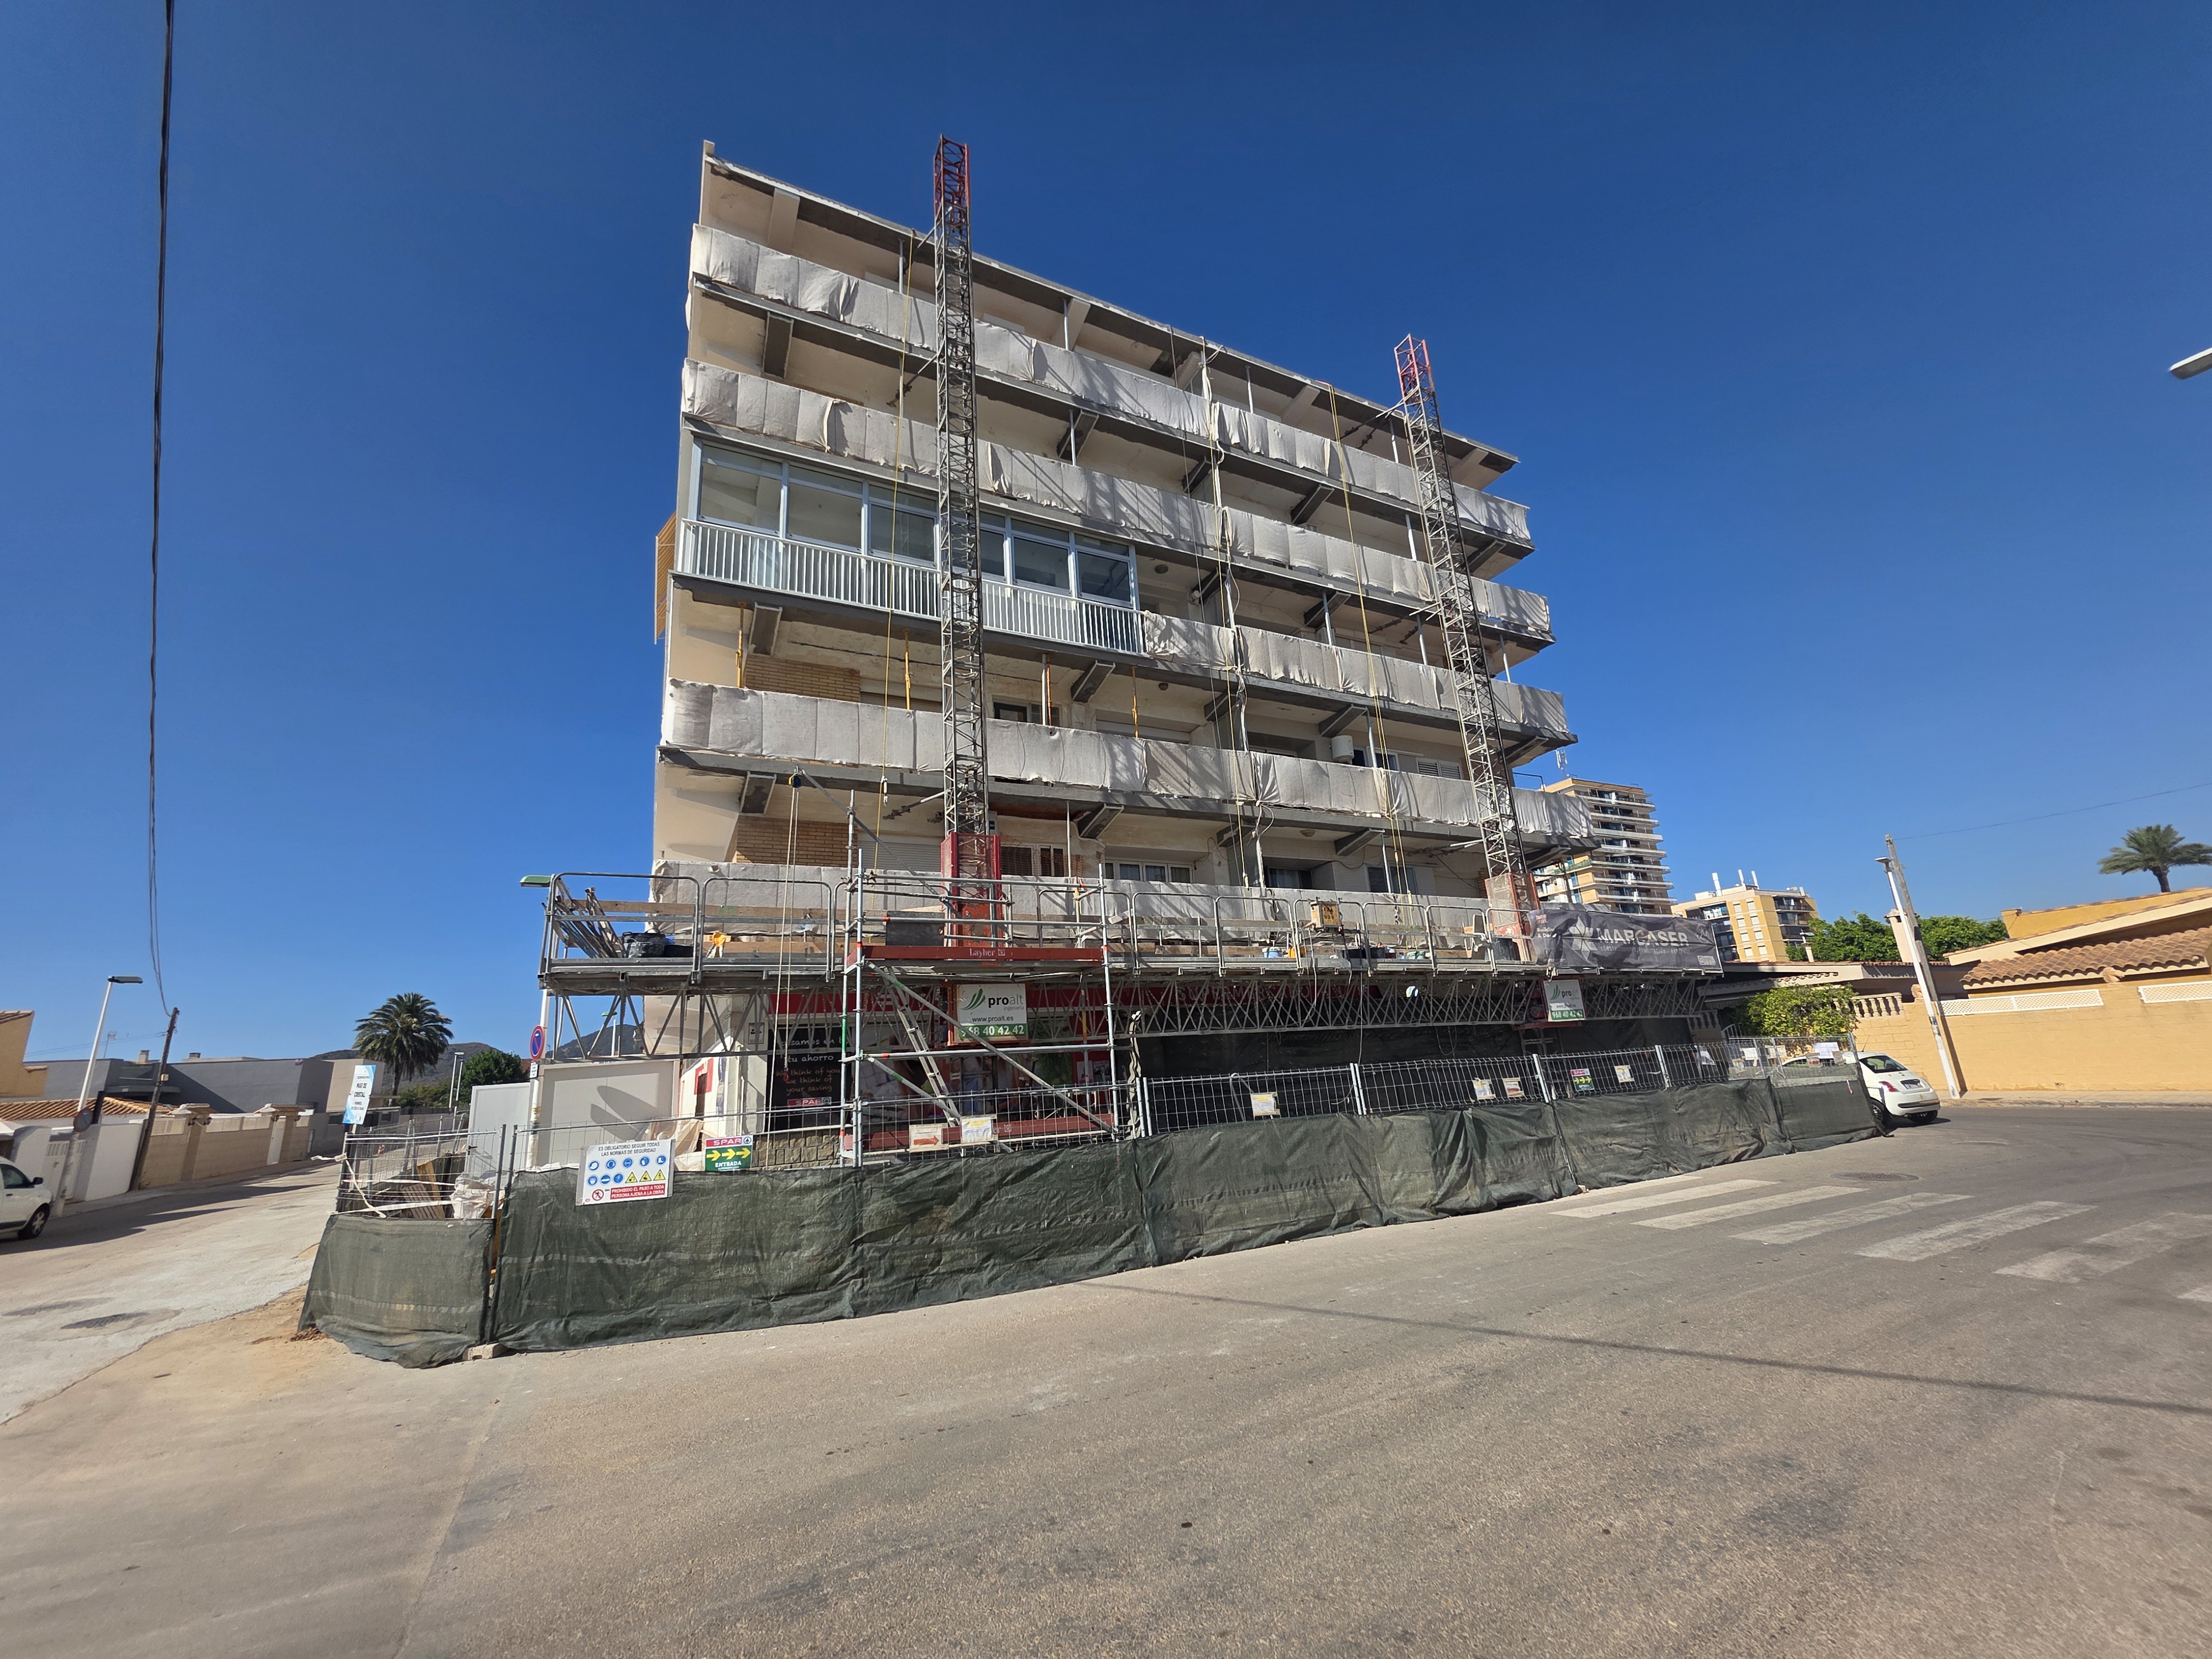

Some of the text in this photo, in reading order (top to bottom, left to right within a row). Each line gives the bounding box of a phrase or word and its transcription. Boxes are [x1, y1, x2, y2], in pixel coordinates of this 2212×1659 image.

[1597, 928, 1689, 947] MARCASER
[969, 948, 995, 957] Layher
[1561, 988, 1579, 998] proalt
[988, 994, 1024, 1008] proalt
[983, 1026, 995, 1036] 40
[998, 1026, 1010, 1035] 42
[1013, 1025, 1024, 1035] 42
[815, 1067, 823, 1076] of
[824, 1075, 832, 1083] of
[786, 1088, 804, 1096] your
